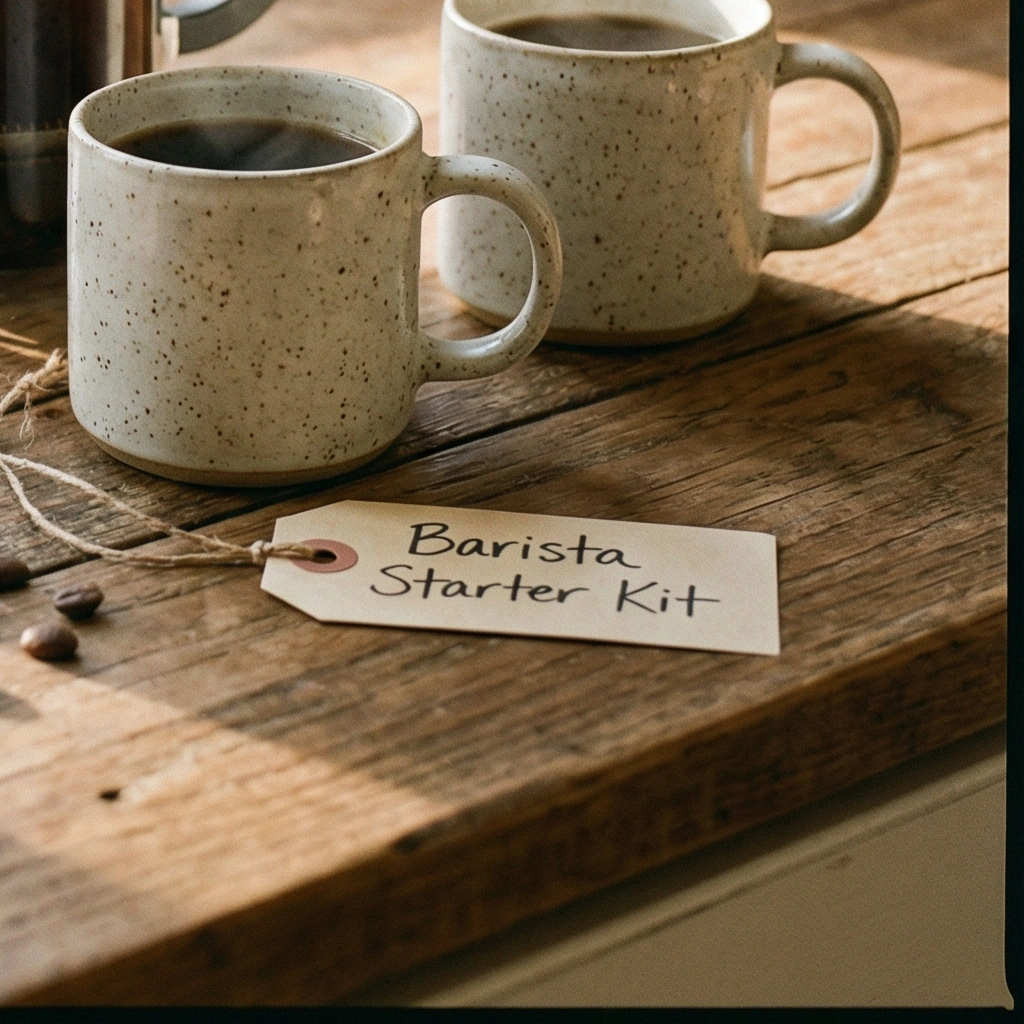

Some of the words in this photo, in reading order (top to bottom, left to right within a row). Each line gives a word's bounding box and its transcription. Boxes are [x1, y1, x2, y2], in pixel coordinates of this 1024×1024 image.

[407, 522, 642, 569] Barista
[370, 564, 589, 604] Starter
[616, 579, 721, 617] Kit
